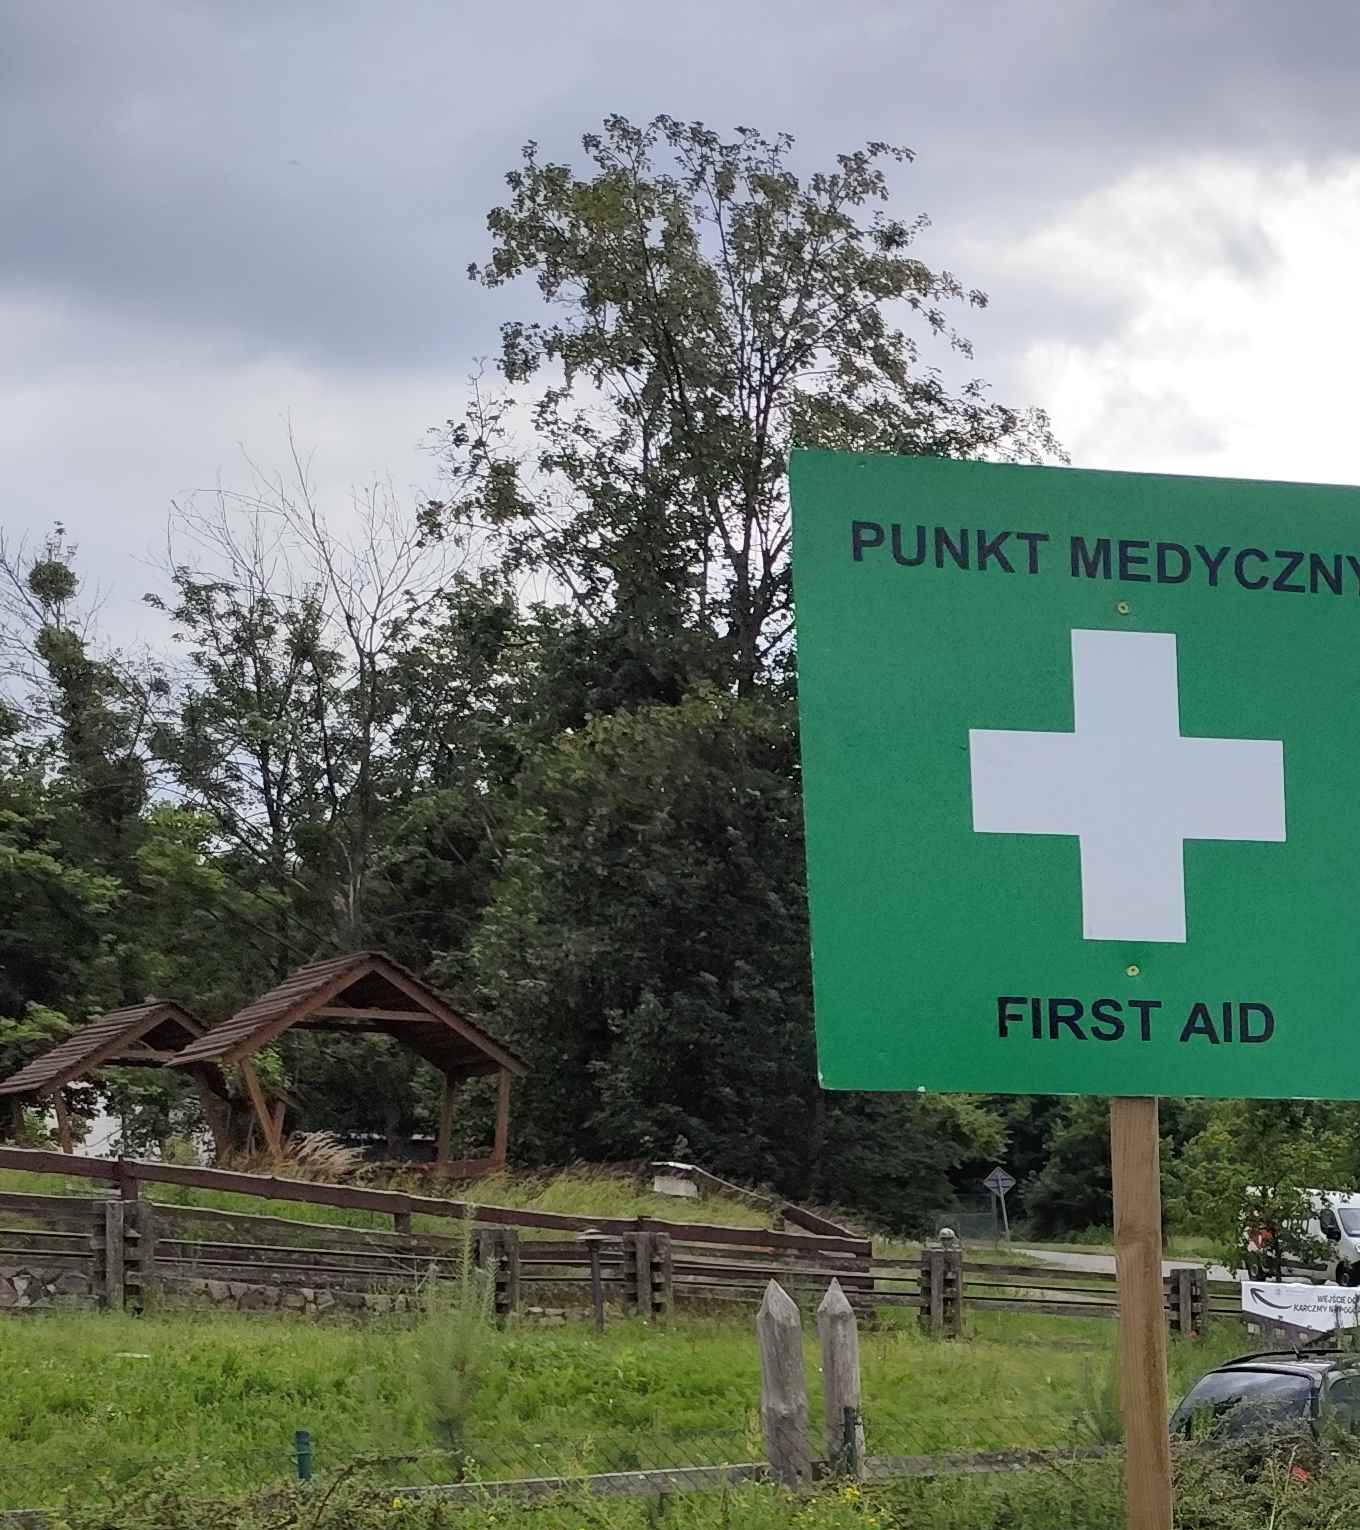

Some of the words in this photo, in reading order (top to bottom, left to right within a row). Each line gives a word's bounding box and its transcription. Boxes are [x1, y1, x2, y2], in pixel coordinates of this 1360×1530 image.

[851, 521, 1049, 577] PUNKT
[997, 996, 1162, 1042] FIRST
[1180, 1001, 1275, 1044] AID
